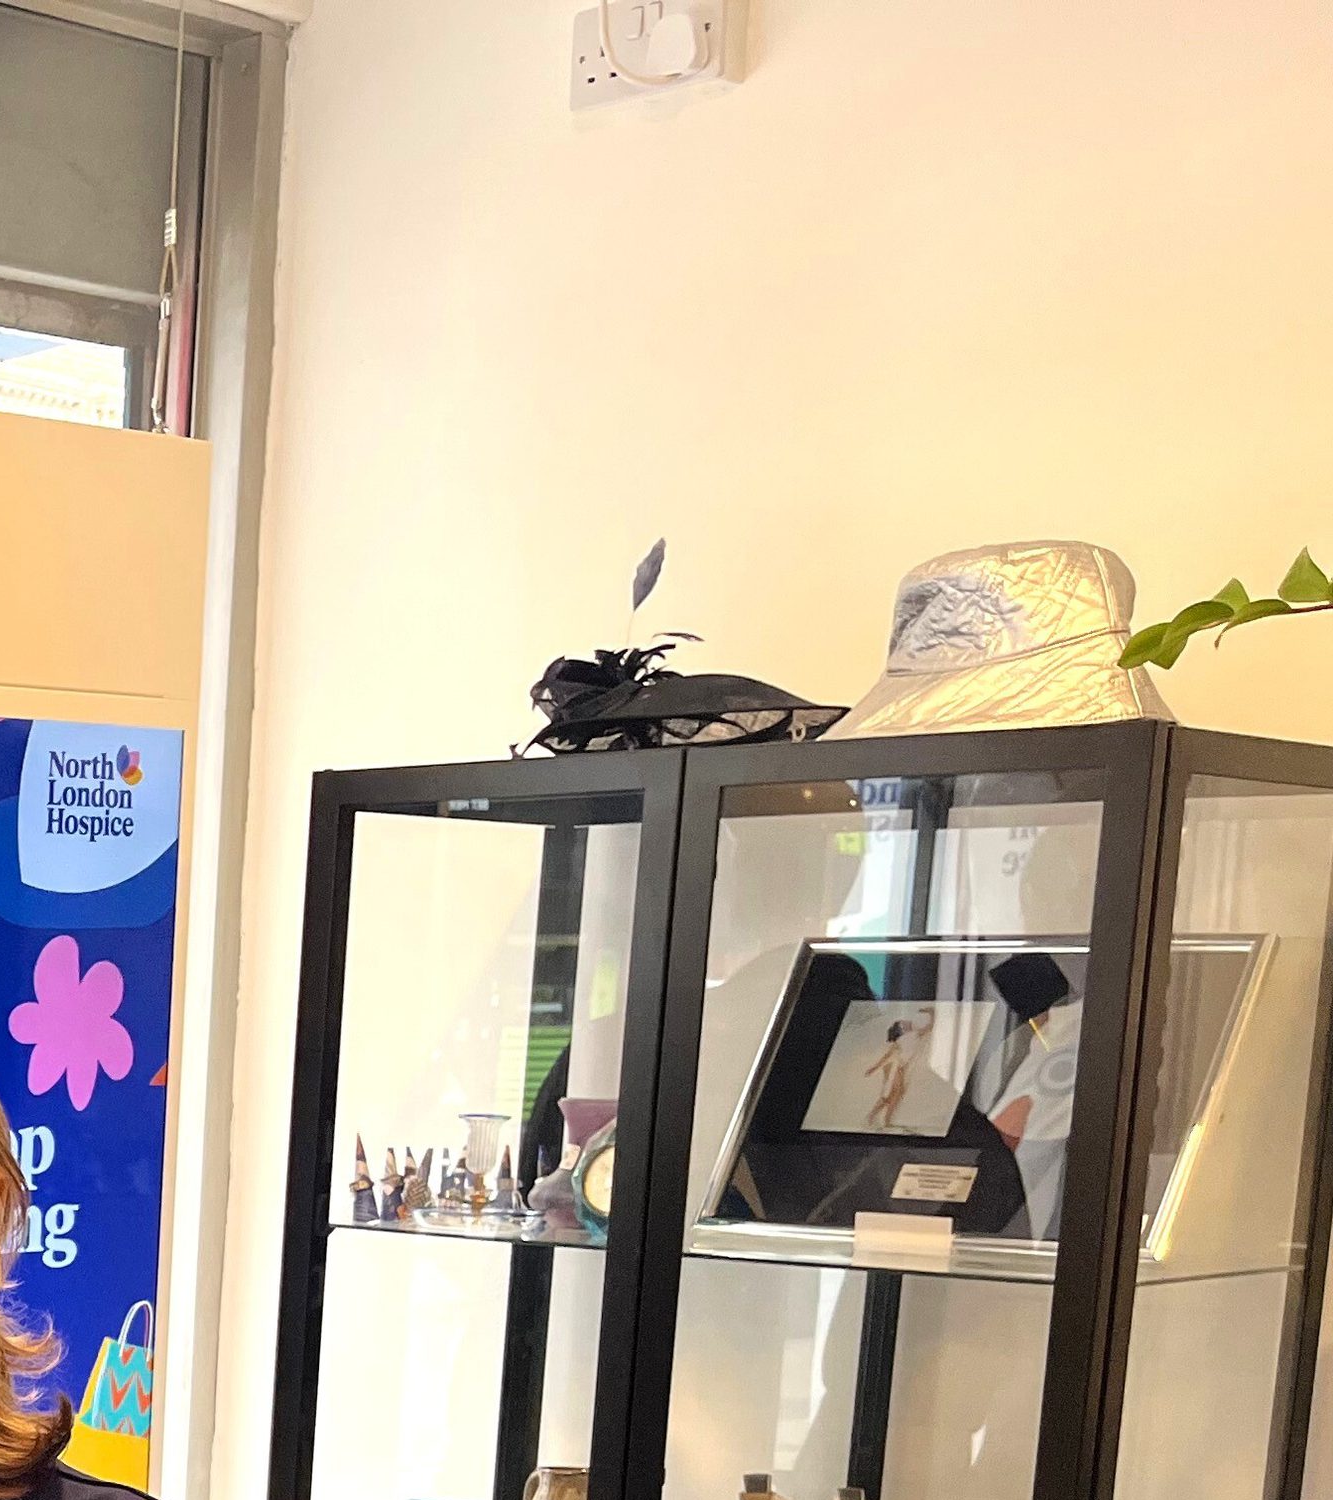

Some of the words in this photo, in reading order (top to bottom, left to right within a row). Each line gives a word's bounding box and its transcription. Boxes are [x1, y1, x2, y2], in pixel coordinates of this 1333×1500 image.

[48, 750, 115, 781] North
[46, 779, 134, 809] London
[45, 807, 135, 843] Hospice
